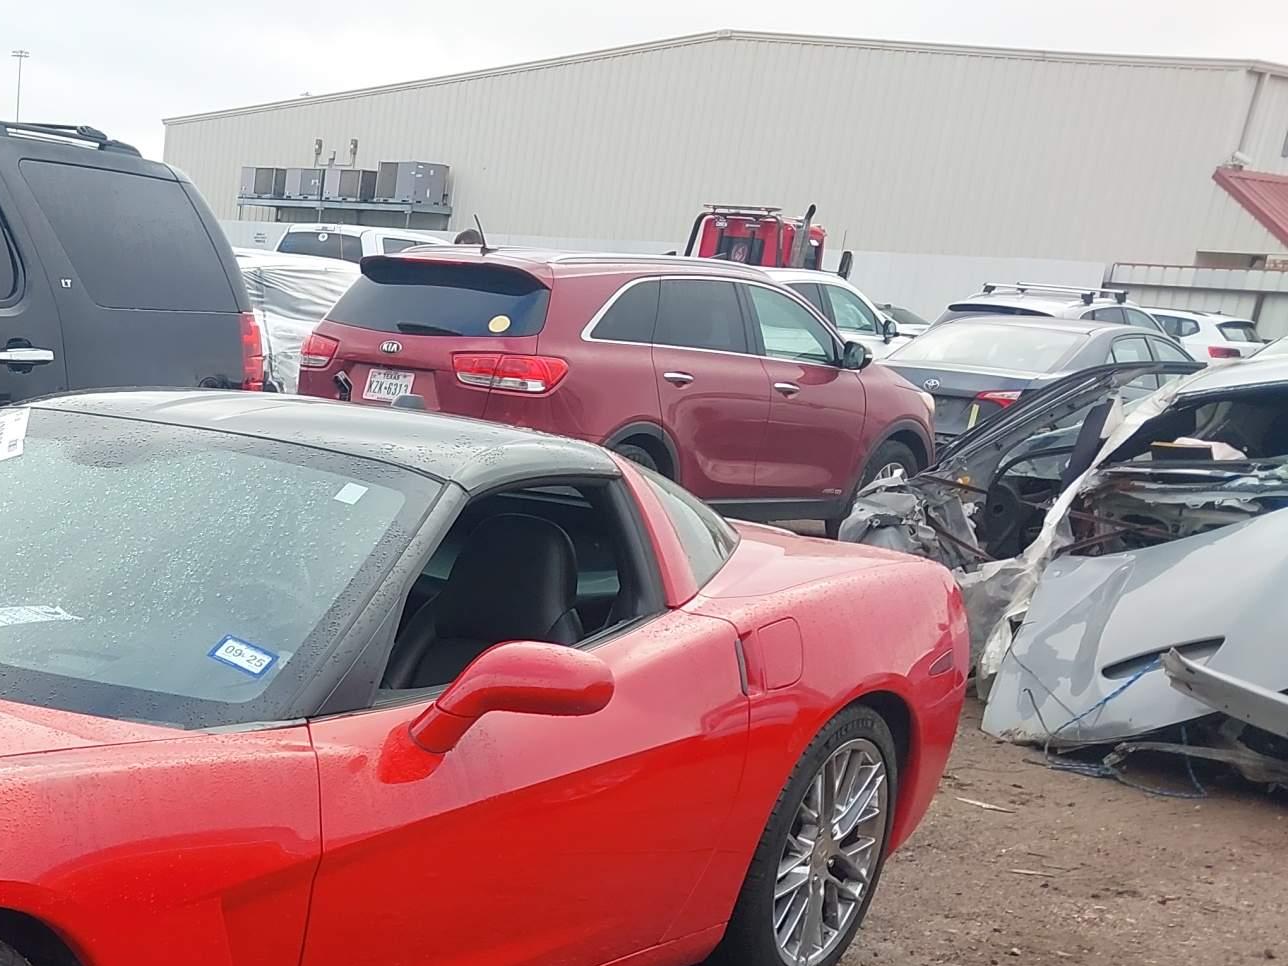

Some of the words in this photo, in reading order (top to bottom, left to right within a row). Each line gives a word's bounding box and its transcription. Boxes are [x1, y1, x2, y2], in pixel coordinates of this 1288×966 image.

[60, 278, 72, 288] LT
[382, 342, 398, 352] KIA
[383, 373, 402, 381] TEXAS
